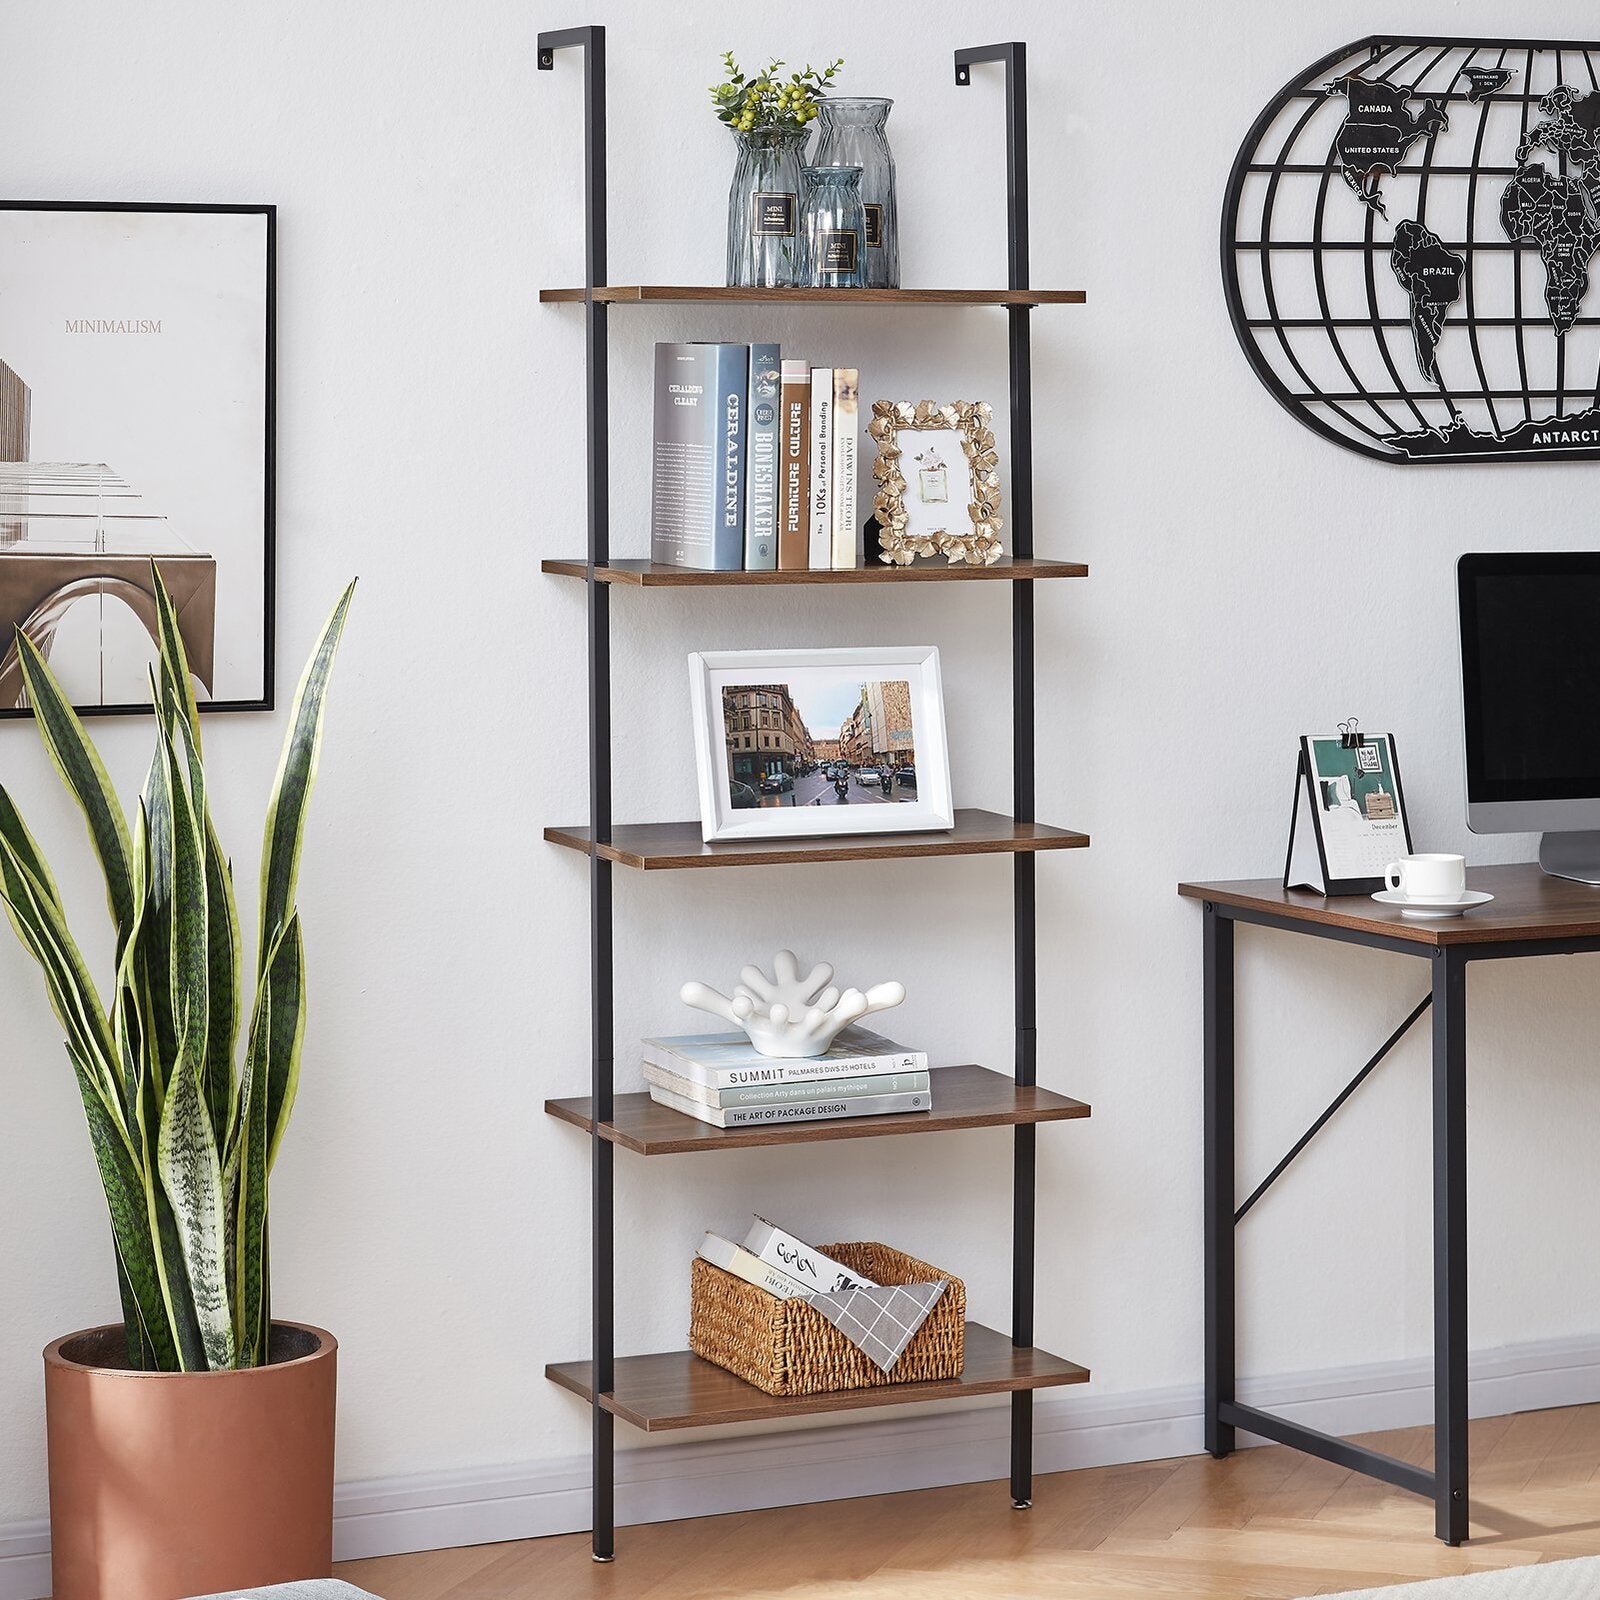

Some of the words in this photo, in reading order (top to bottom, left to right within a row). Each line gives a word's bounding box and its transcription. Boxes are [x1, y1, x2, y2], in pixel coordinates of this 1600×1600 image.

[1358, 104, 1393, 113] CANADA
[1344, 146, 1372, 154] UNITED
[1372, 146, 1400, 154] STATES
[1343, 170, 1363, 197] MEXICO
[1396, 266, 1406, 282] PERU
[1422, 267, 1455, 276] BRAZIL
[65, 319, 162, 333] MINIMALISM
[1418, 314, 1436, 344] ARGENTINA
[789, 402, 802, 458] CULTURE
[819, 401, 829, 439] Branding
[1532, 429, 1600, 444] ANTARCT
[818, 441, 827, 479] Personal
[754, 432, 774, 538] BONESHAKER
[816, 488, 826, 516] 10Ks
[845, 494, 853, 531] TEORI
[729, 1068, 785, 1084] SUMMIT
[788, 1066, 824, 1076] PALMARES
[824, 1065, 840, 1073] DWS
[849, 1062, 876, 1071] HOTELS
[739, 1090, 774, 1100] Collection
[774, 1089, 788, 1098] Arty
[789, 1088, 806, 1096] dans
[816, 1085, 837, 1095] palais
[733, 1113, 747, 1121] THE
[748, 1111, 763, 1120] ART
[764, 1110, 776, 1119] OF
[777, 1106, 816, 1117] PACKAGE
[817, 1104, 847, 1114] DESIGN
